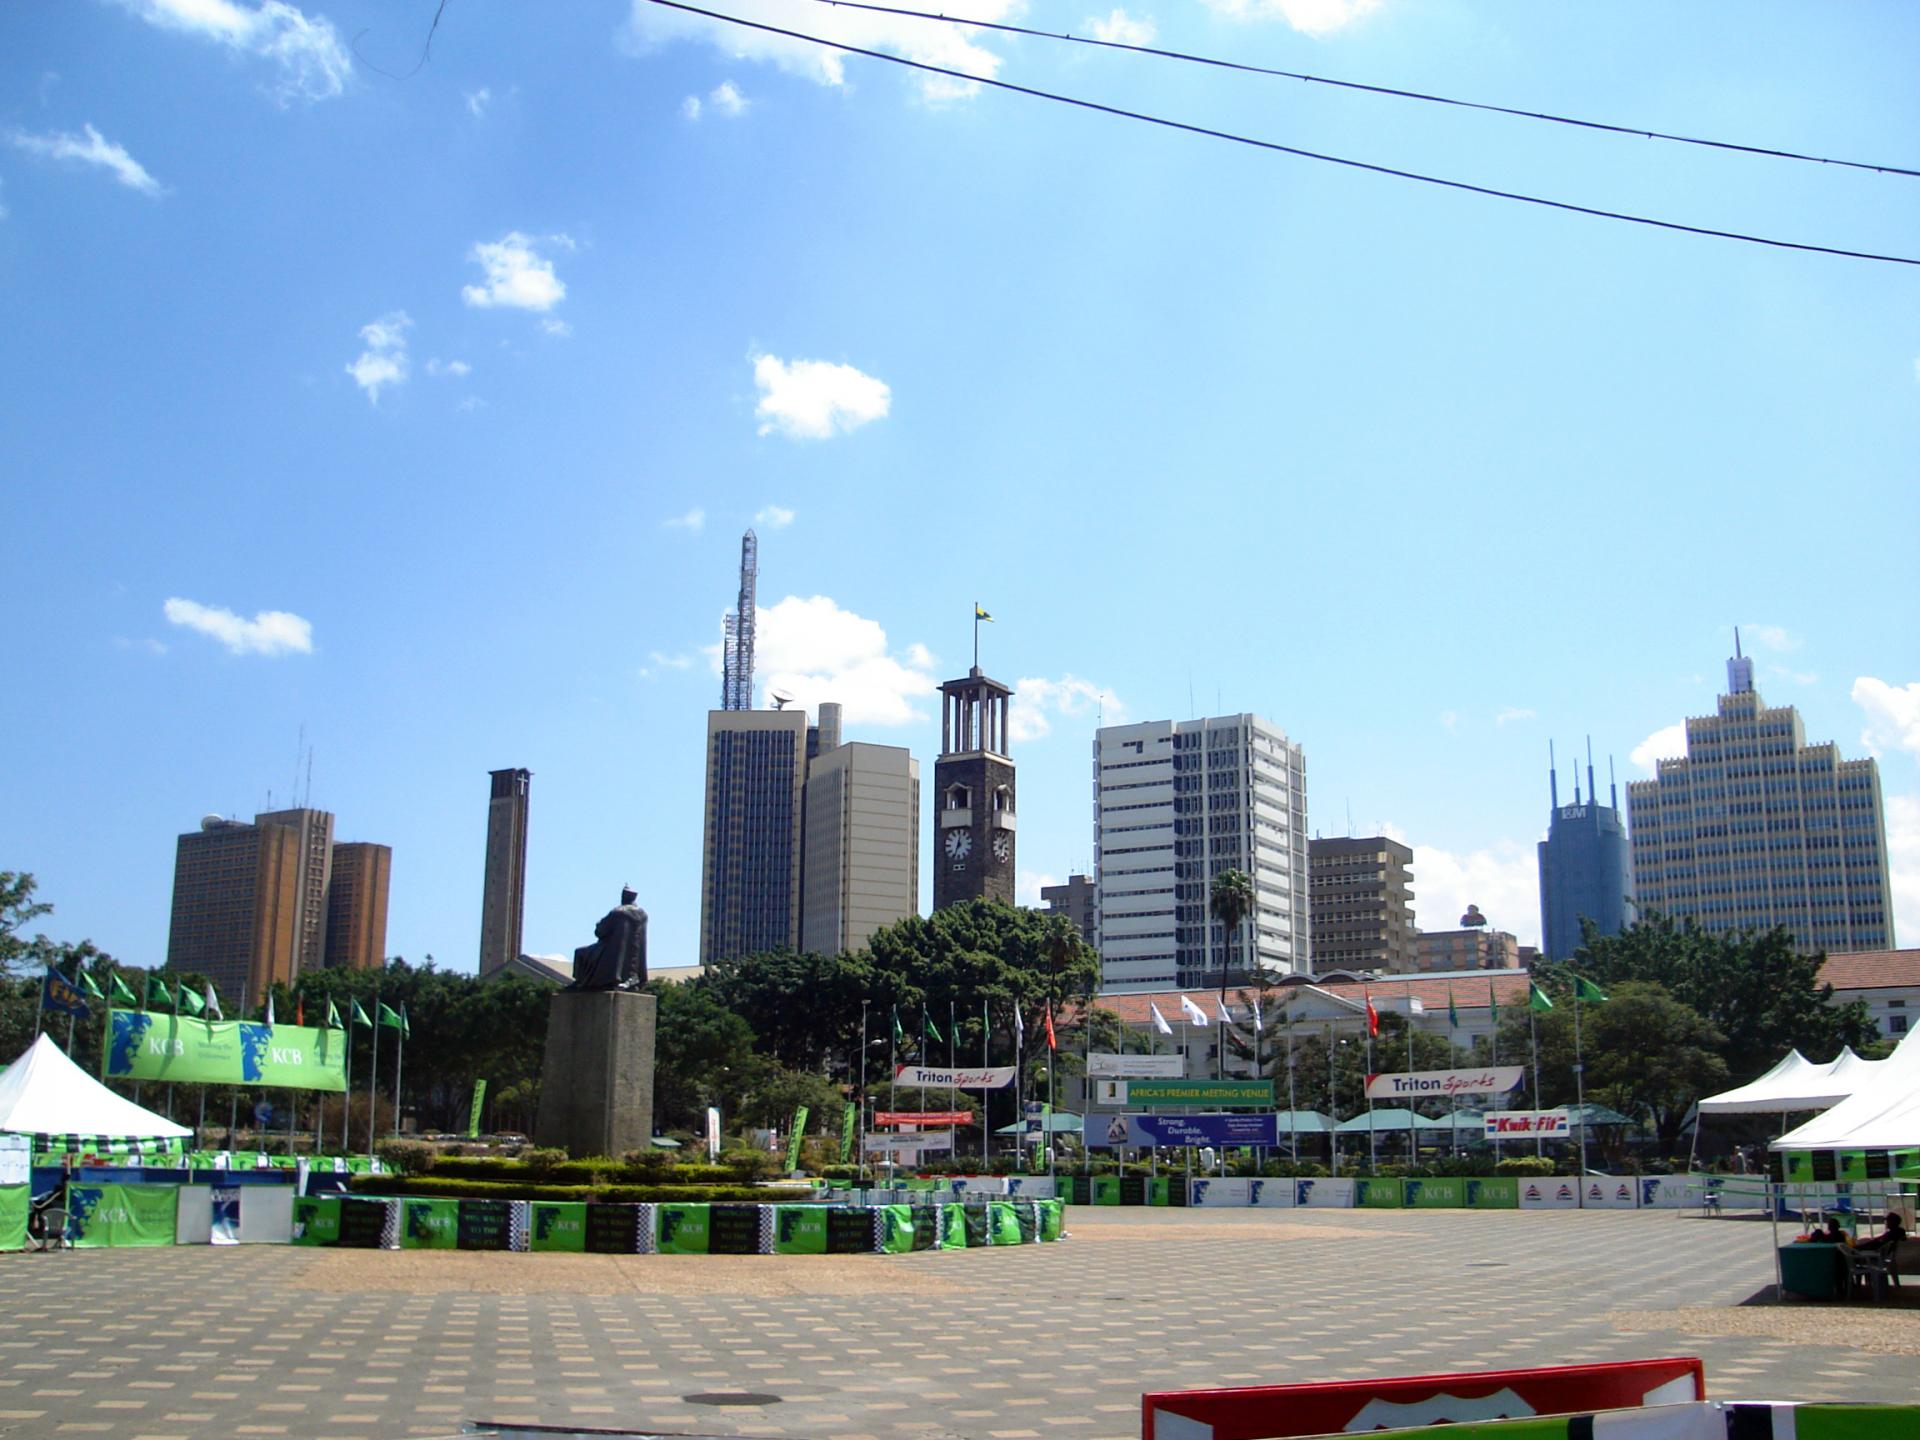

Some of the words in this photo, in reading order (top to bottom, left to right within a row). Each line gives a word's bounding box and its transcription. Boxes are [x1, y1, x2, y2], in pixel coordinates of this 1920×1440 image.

[150, 1038, 184, 1057] KCB
[272, 1047, 303, 1065] KCB
[916, 1070, 952, 1083] Triton
[953, 1072, 995, 1088] Sports
[1392, 1077, 1441, 1092] Triton
[1442, 1073, 1496, 1093] Sports
[1130, 1088, 1165, 1097] AFRICA'S
[1166, 1088, 1200, 1097] PREMIER
[1201, 1088, 1239, 1097] MEETING
[1240, 1088, 1269, 1098] VENUE
[99, 1208, 128, 1223] KCB
[800, 1222, 821, 1233] KCB
